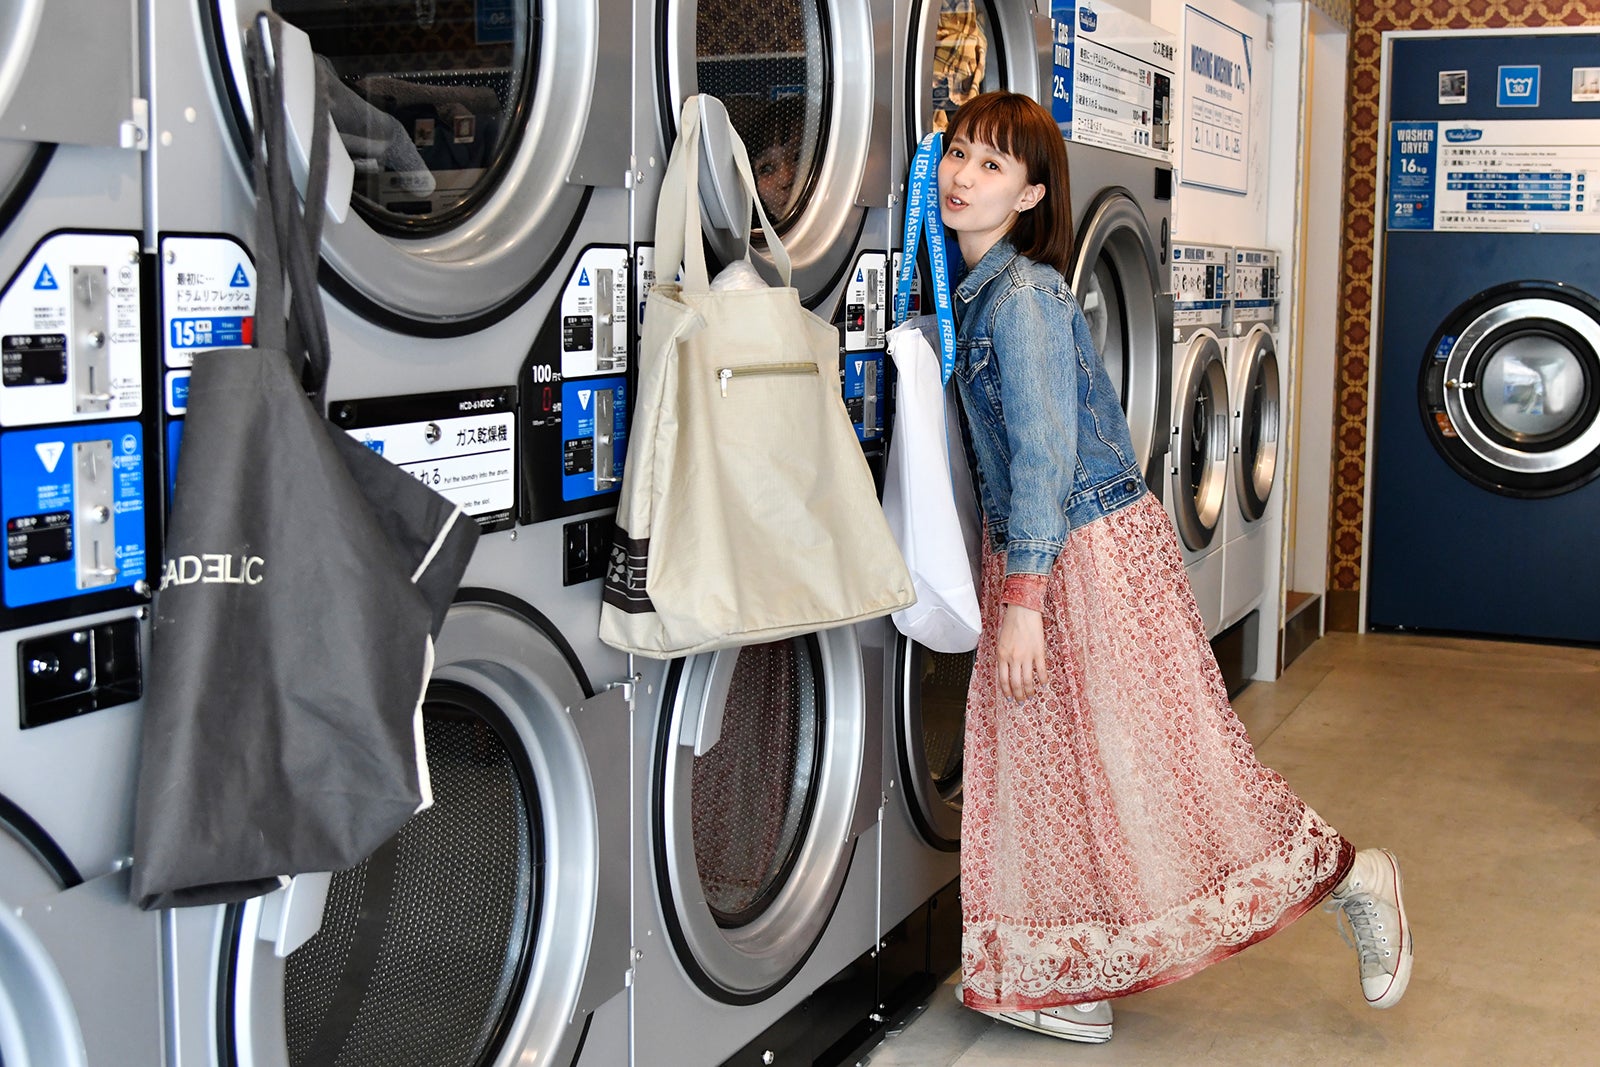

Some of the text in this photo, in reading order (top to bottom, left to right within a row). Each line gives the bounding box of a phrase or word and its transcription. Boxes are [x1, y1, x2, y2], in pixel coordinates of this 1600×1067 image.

[1512, 83, 1524, 93] 30
[1397, 129, 1433, 142] WASHER
[1401, 142, 1429, 154] DRYER
[914, 154, 930, 179] LECK
[1401, 158, 1428, 174] 16kg
[911, 182, 922, 206] sein
[1395, 203, 1403, 214] 2
[927, 210, 940, 234] sein
[901, 206, 921, 281] WASCHSALON
[1160, 217, 1168, 266] 9
[931, 235, 949, 309] WASCHSALON
[177, 290, 251, 302] ドラムリフレッシュ
[173, 321, 195, 346] 15
[941, 319, 953, 360] FREDDY
[532, 364, 551, 383] 100
[543, 386, 551, 411] 0
[456, 425, 508, 447] ガス乾燥機
